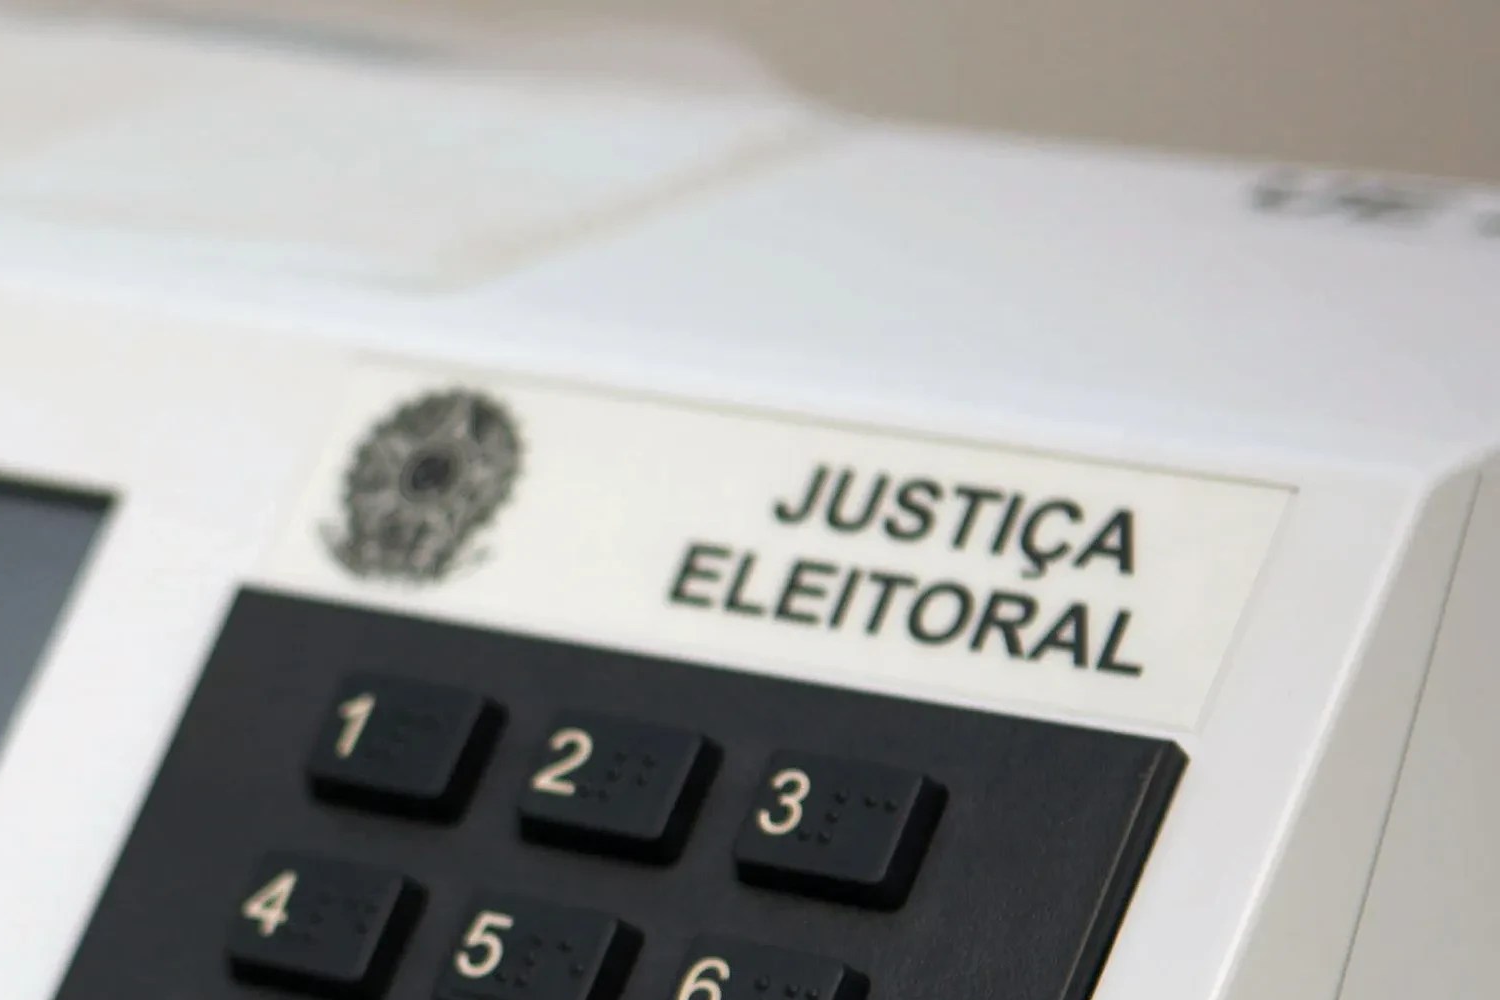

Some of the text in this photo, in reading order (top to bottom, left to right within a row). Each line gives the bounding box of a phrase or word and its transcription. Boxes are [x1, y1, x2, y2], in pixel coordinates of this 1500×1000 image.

[773, 463, 1135, 578] JUSTIÇA
[668, 541, 1144, 678] ELEITORAL
[338, 694, 375, 758] 1
[532, 728, 594, 796] 2
[757, 768, 812, 836] 3
[242, 871, 298, 936] 4
[455, 910, 514, 979] 5
